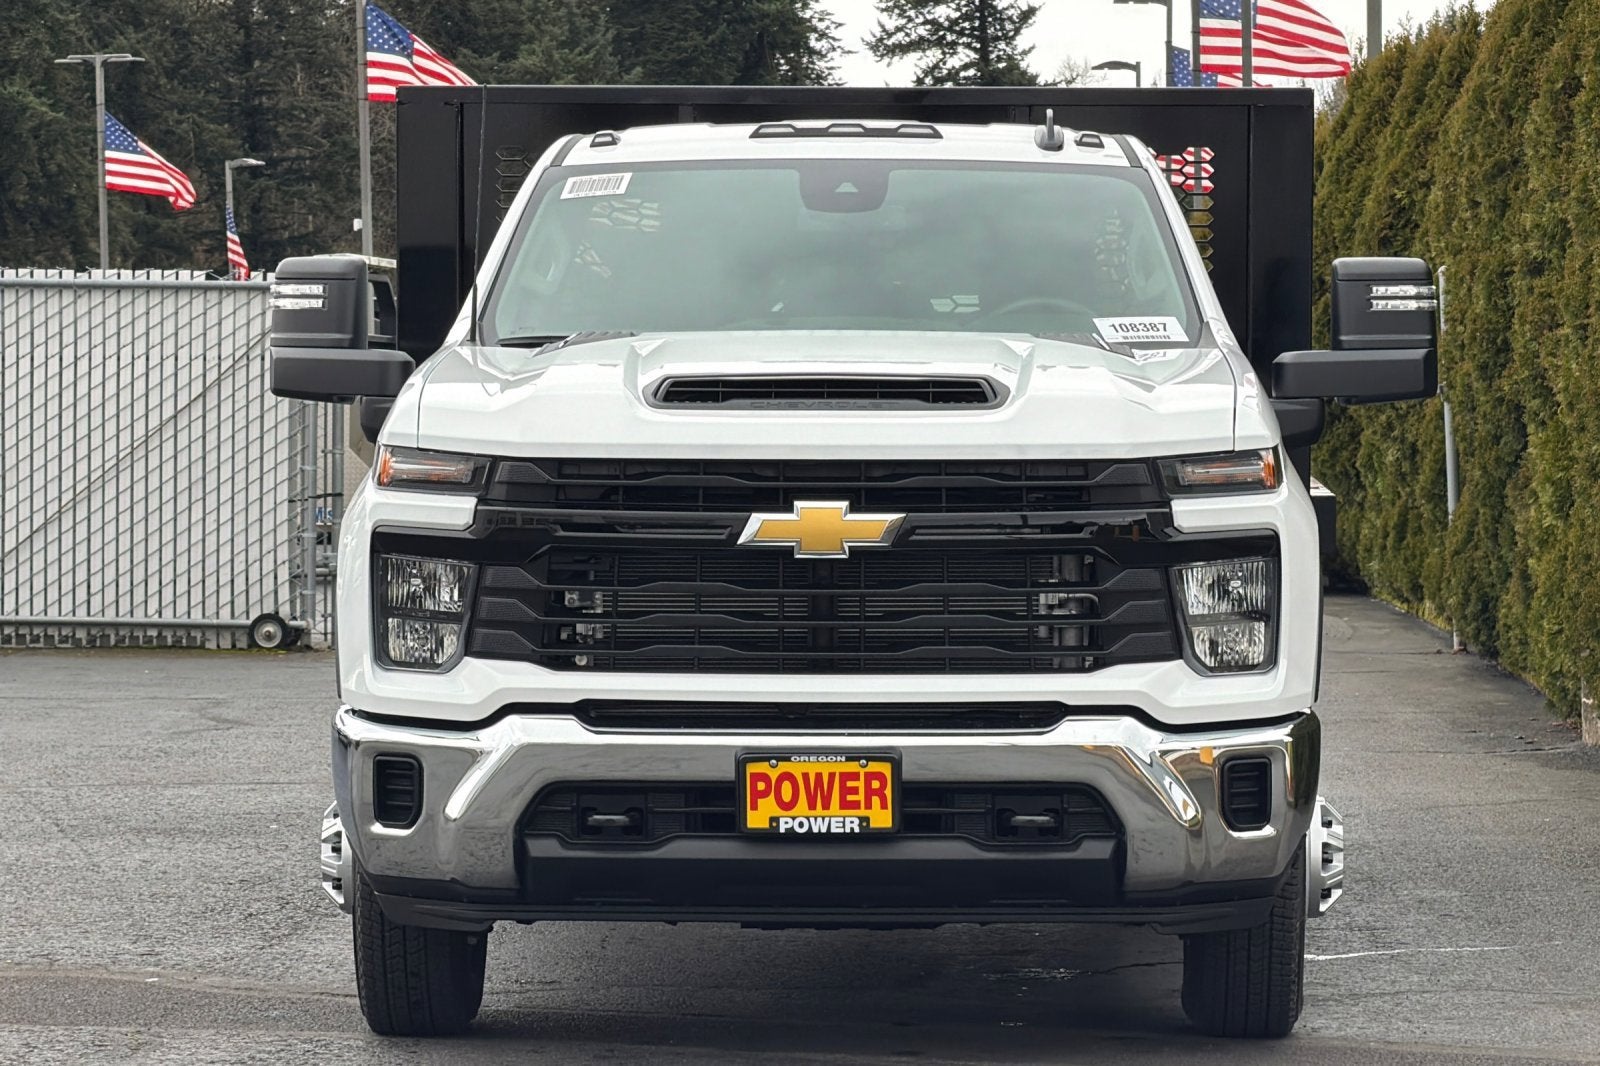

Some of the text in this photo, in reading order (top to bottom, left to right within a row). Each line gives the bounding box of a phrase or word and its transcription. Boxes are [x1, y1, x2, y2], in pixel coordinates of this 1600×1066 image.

[1109, 322, 1168, 334] 108387
[750, 401, 900, 409] CHEVROLET
[749, 771, 889, 812] POWER
[779, 817, 860, 833] POWER
